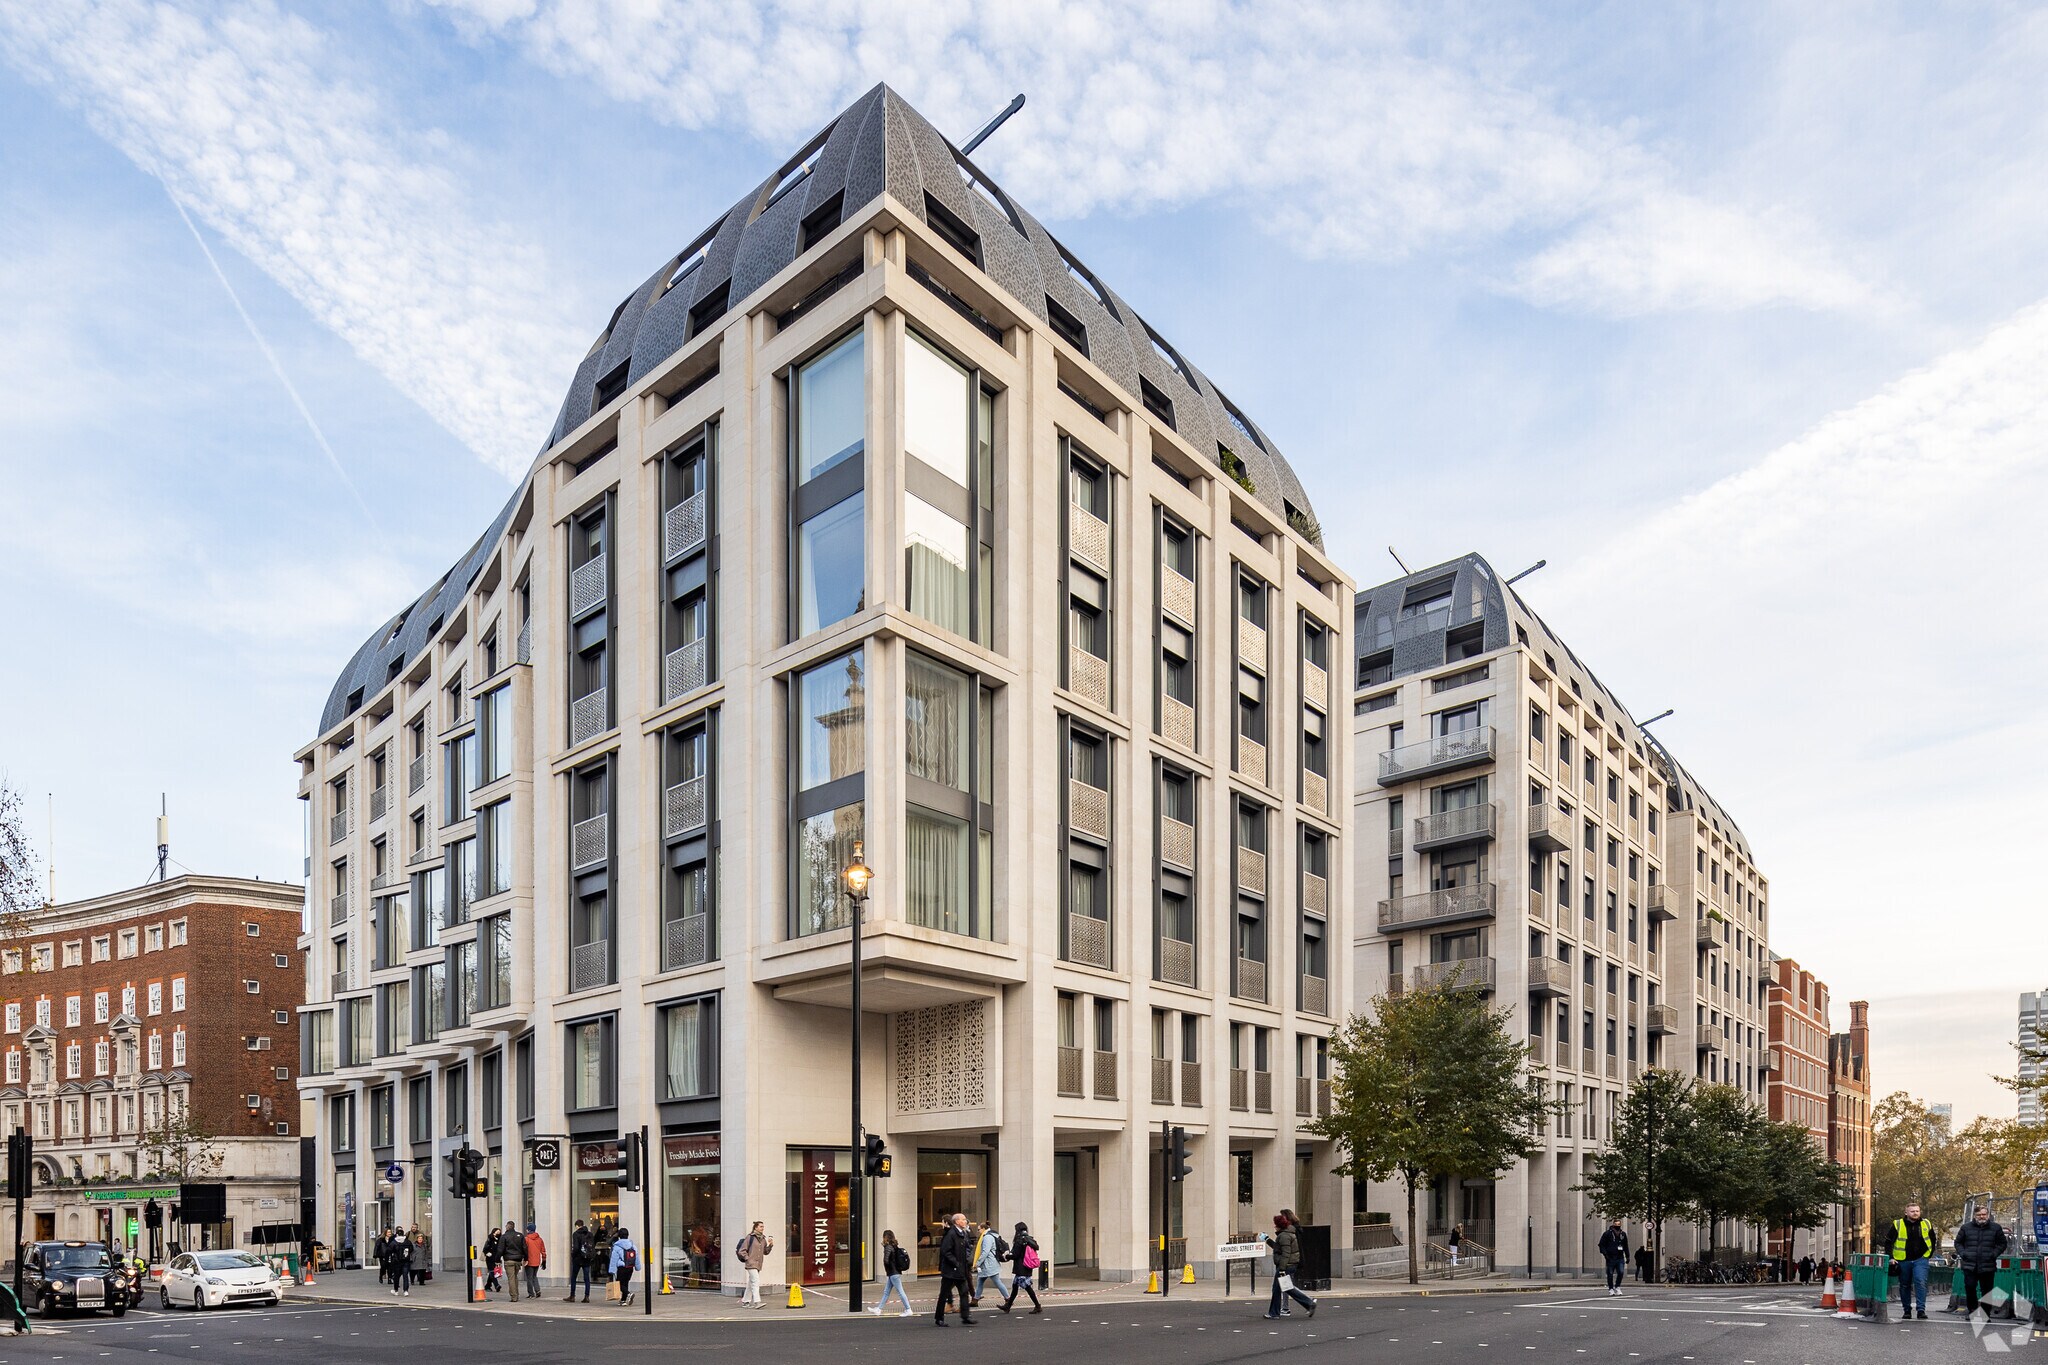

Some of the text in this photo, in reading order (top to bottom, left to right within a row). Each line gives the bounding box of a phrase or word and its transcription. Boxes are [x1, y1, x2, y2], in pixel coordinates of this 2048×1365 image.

[540, 1150, 553, 1160] PRET
[669, 1148, 720, 1161] Freshly Made Food
[583, 1156, 601, 1167] Organic
[601, 1155, 617, 1164] Coffee
[815, 1174, 828, 1202] PRET
[815, 1206, 828, 1214] A
